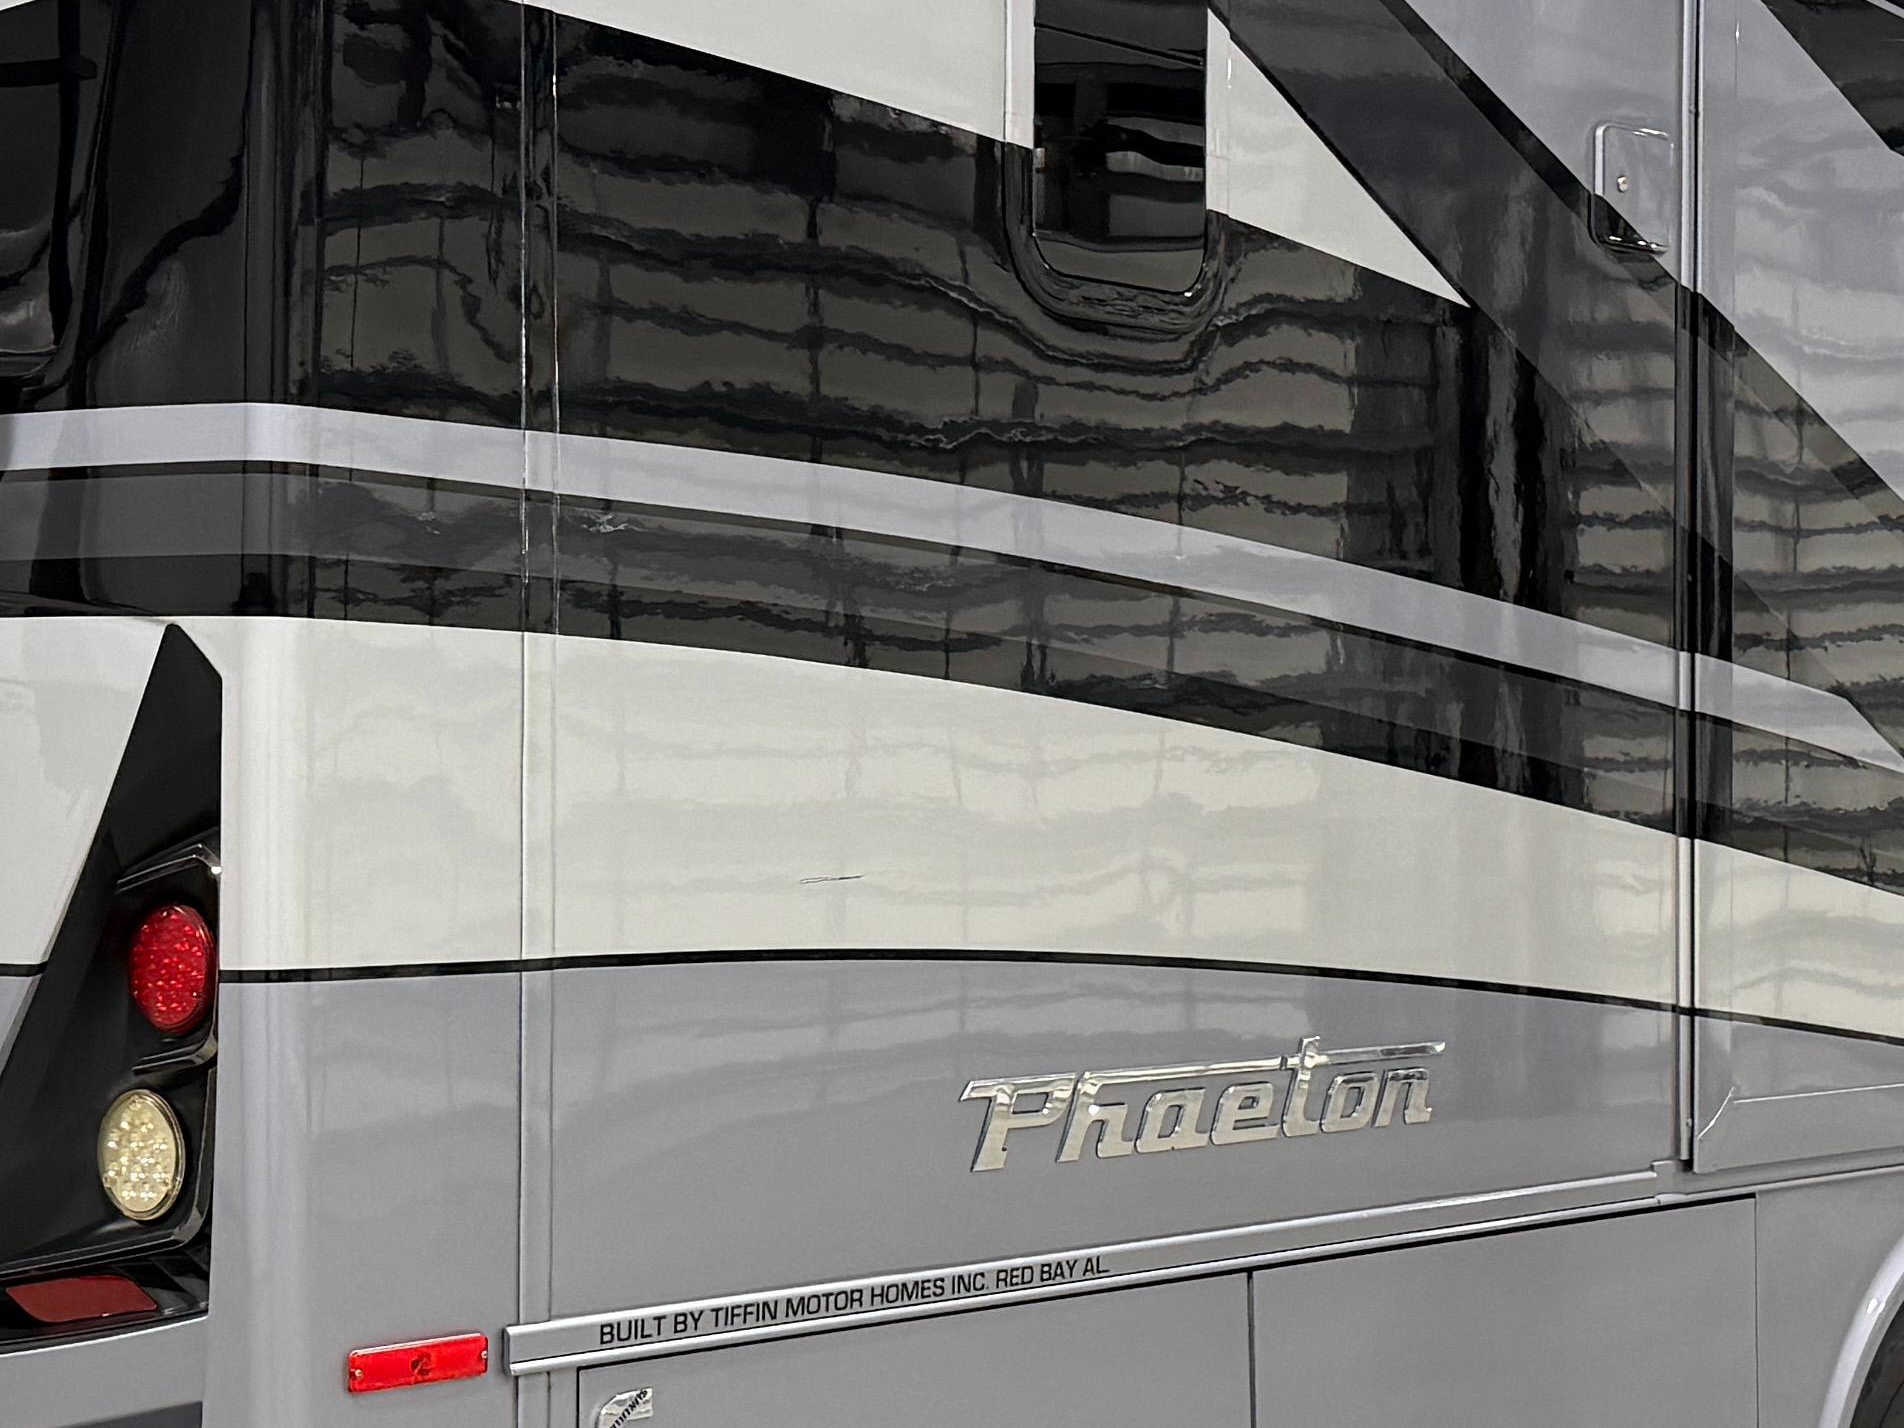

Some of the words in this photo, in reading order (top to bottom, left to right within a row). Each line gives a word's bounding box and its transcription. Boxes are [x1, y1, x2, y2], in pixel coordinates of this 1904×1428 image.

[959, 1035, 1447, 1172] Phaeton
[599, 1316, 667, 1345] BUILT
[673, 1310, 705, 1334] BY
[710, 1299, 778, 1328] TIFFIN
[785, 1288, 864, 1318] MOTOR
[870, 1277, 945, 1306] HOMES
[995, 1264, 1034, 1290] RED
[1040, 1258, 1079, 1283] BAY
